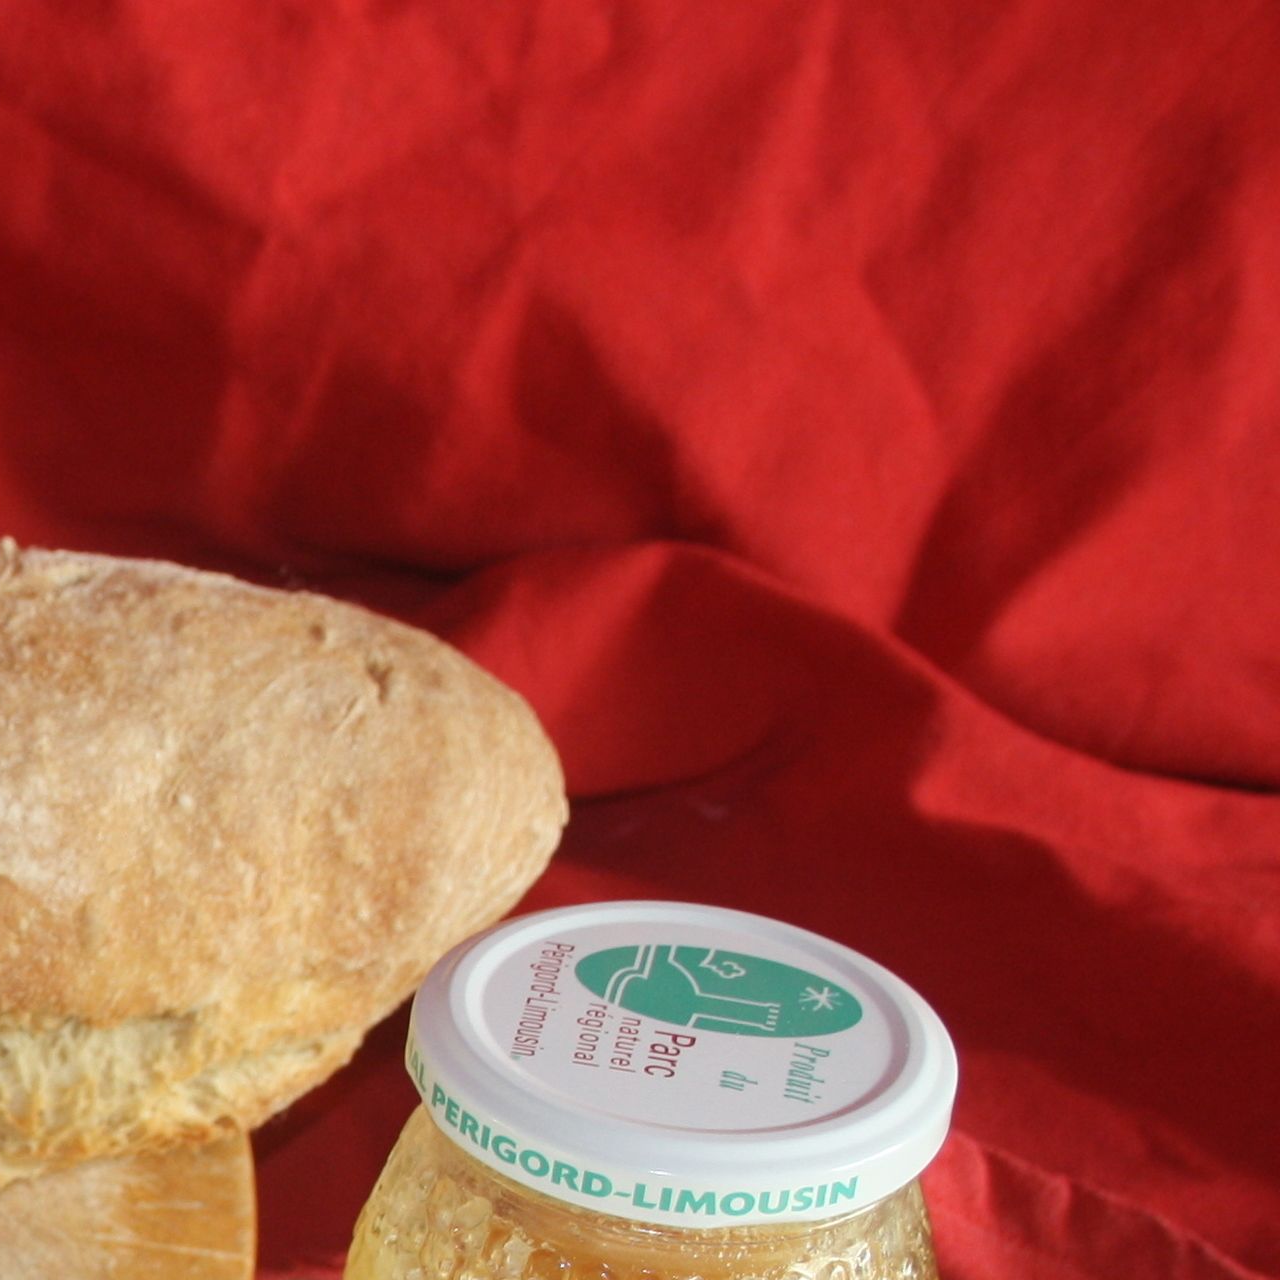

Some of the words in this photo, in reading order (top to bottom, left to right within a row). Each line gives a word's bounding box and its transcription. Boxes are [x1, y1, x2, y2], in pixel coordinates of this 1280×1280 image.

[509, 941, 575, 1057] Périgord-Limousin
[572, 1002, 608, 1067] régional
[609, 1016, 641, 1073] naturel
[644, 1030, 696, 1079] Parc
[719, 1069, 757, 1092] du
[784, 1042, 830, 1104] Produit
[431, 1083, 858, 1216] PERIGORD-LIMOUSIN
